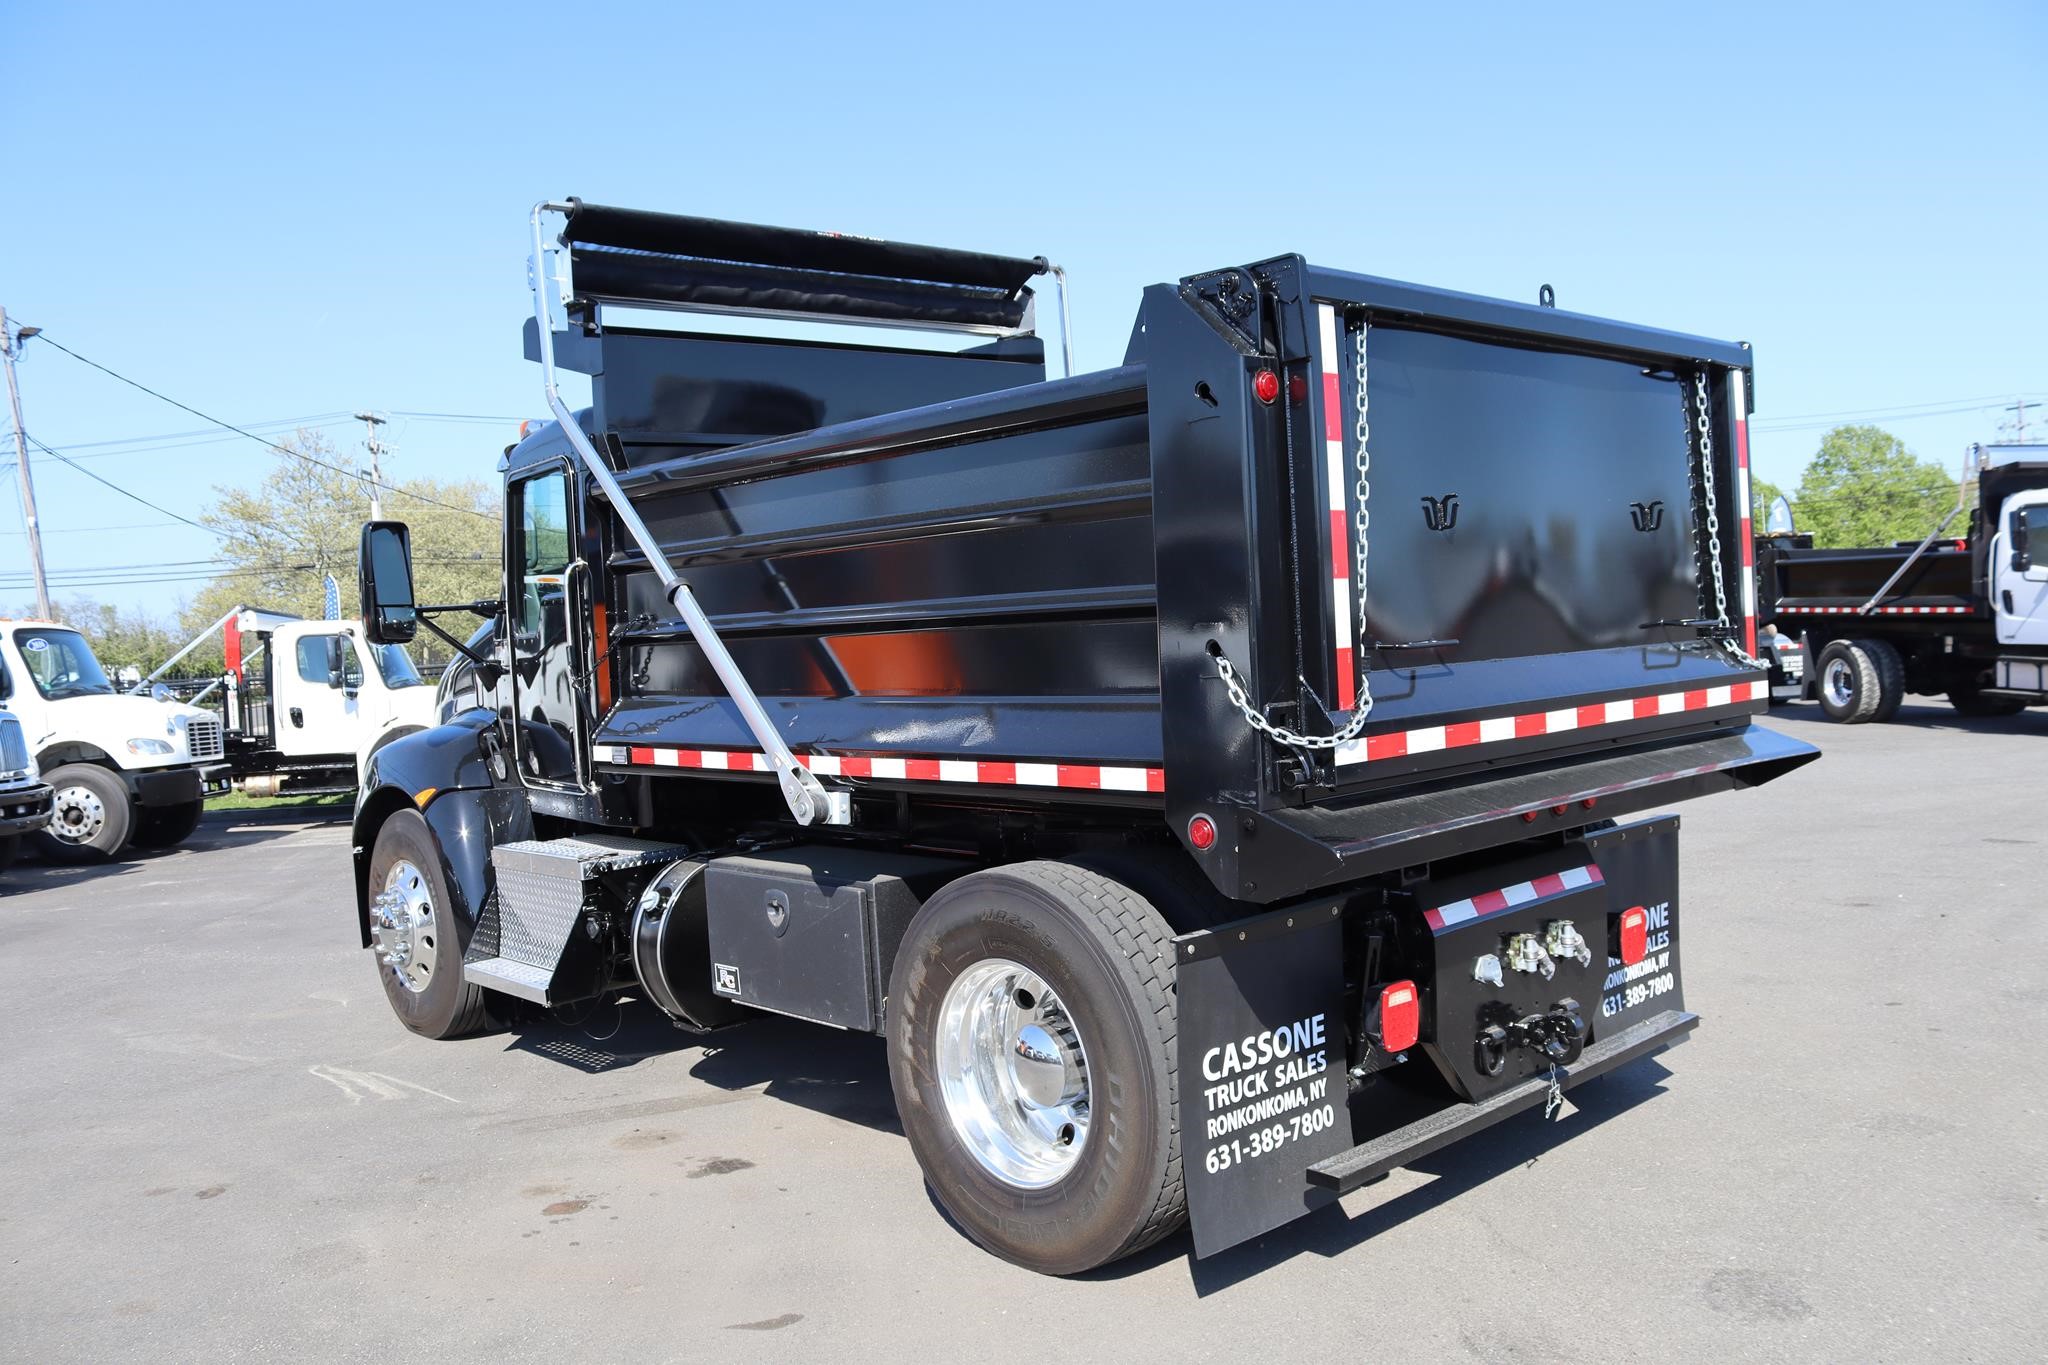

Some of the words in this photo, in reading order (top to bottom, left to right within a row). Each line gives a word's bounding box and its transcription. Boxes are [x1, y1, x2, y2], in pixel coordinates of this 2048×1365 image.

[1645, 930, 1669, 955] ALES
[1659, 951, 1669, 970] NY
[1602, 972, 1674, 1018] 631-389-7800
[1202, 1013, 1326, 1082] CASSONE
[1204, 1070, 1269, 1112] TRUCK
[1275, 1050, 1327, 1088] SALES
[1206, 1086, 1309, 1140] RONKONKOMA,
[1309, 1078, 1327, 1102] NY
[1205, 1104, 1335, 1174] 631-389-7800
